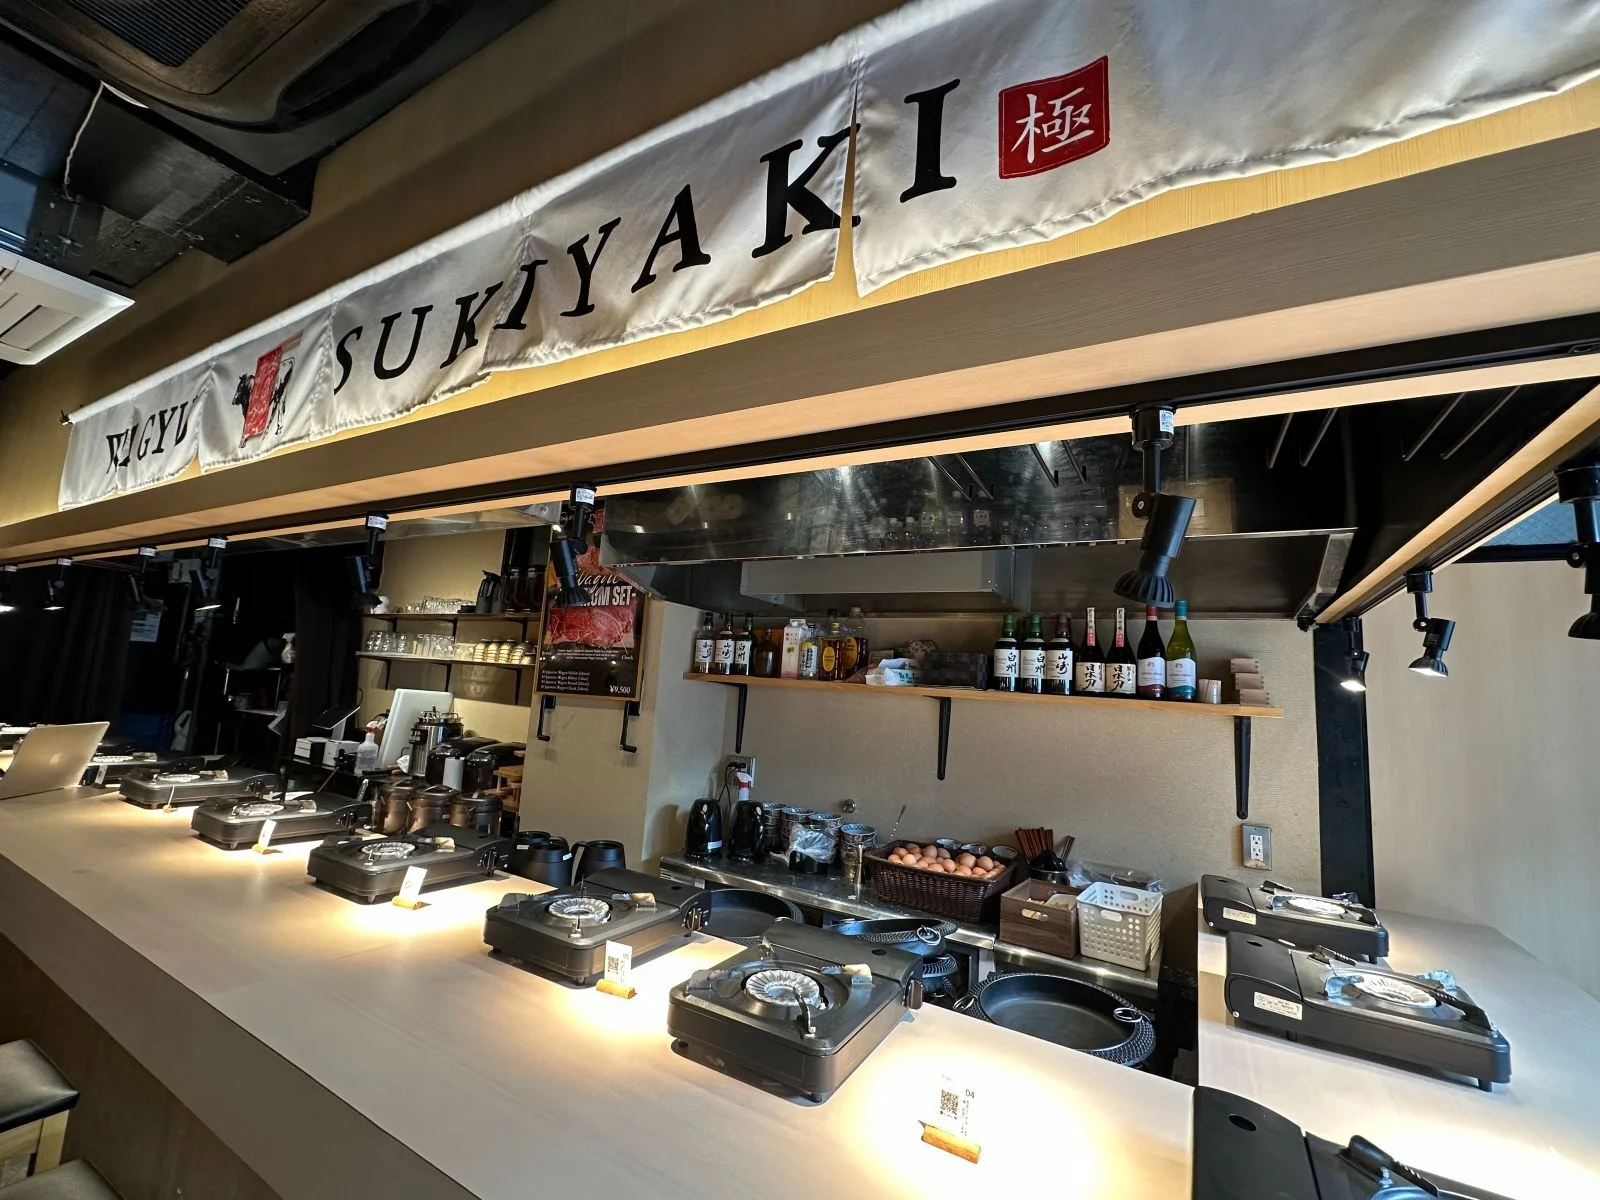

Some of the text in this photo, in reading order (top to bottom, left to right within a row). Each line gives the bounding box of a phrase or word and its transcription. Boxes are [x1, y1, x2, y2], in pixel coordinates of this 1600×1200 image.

[1010, 86, 1095, 164] 極
[333, 78, 961, 395] SUKIYAKI
[1005, 651, 1017, 674] 白州
[1034, 653, 1046, 676] 白州
[609, 684, 631, 694] ¥9,500
